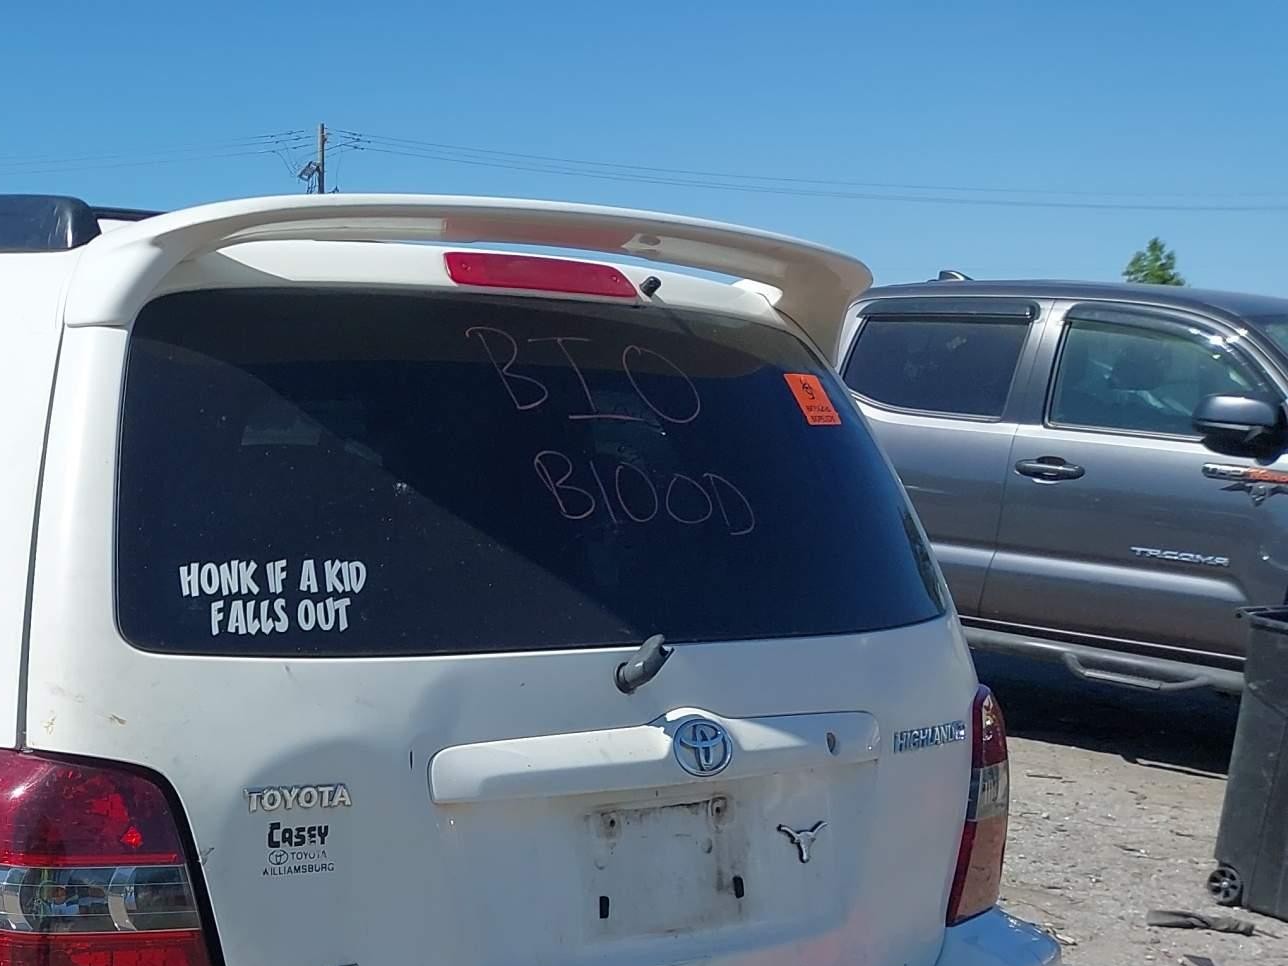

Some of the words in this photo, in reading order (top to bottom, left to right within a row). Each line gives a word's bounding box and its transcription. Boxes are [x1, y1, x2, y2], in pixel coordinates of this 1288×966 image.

[465, 326, 701, 424] BIO
[179, 559, 260, 597] HONK
[266, 558, 287, 595] IF
[299, 558, 319, 593] A
[323, 558, 367, 594] KID
[211, 598, 289, 636] FALLS
[297, 597, 352, 633] OUT
[244, 783, 352, 814] TOYOTA
